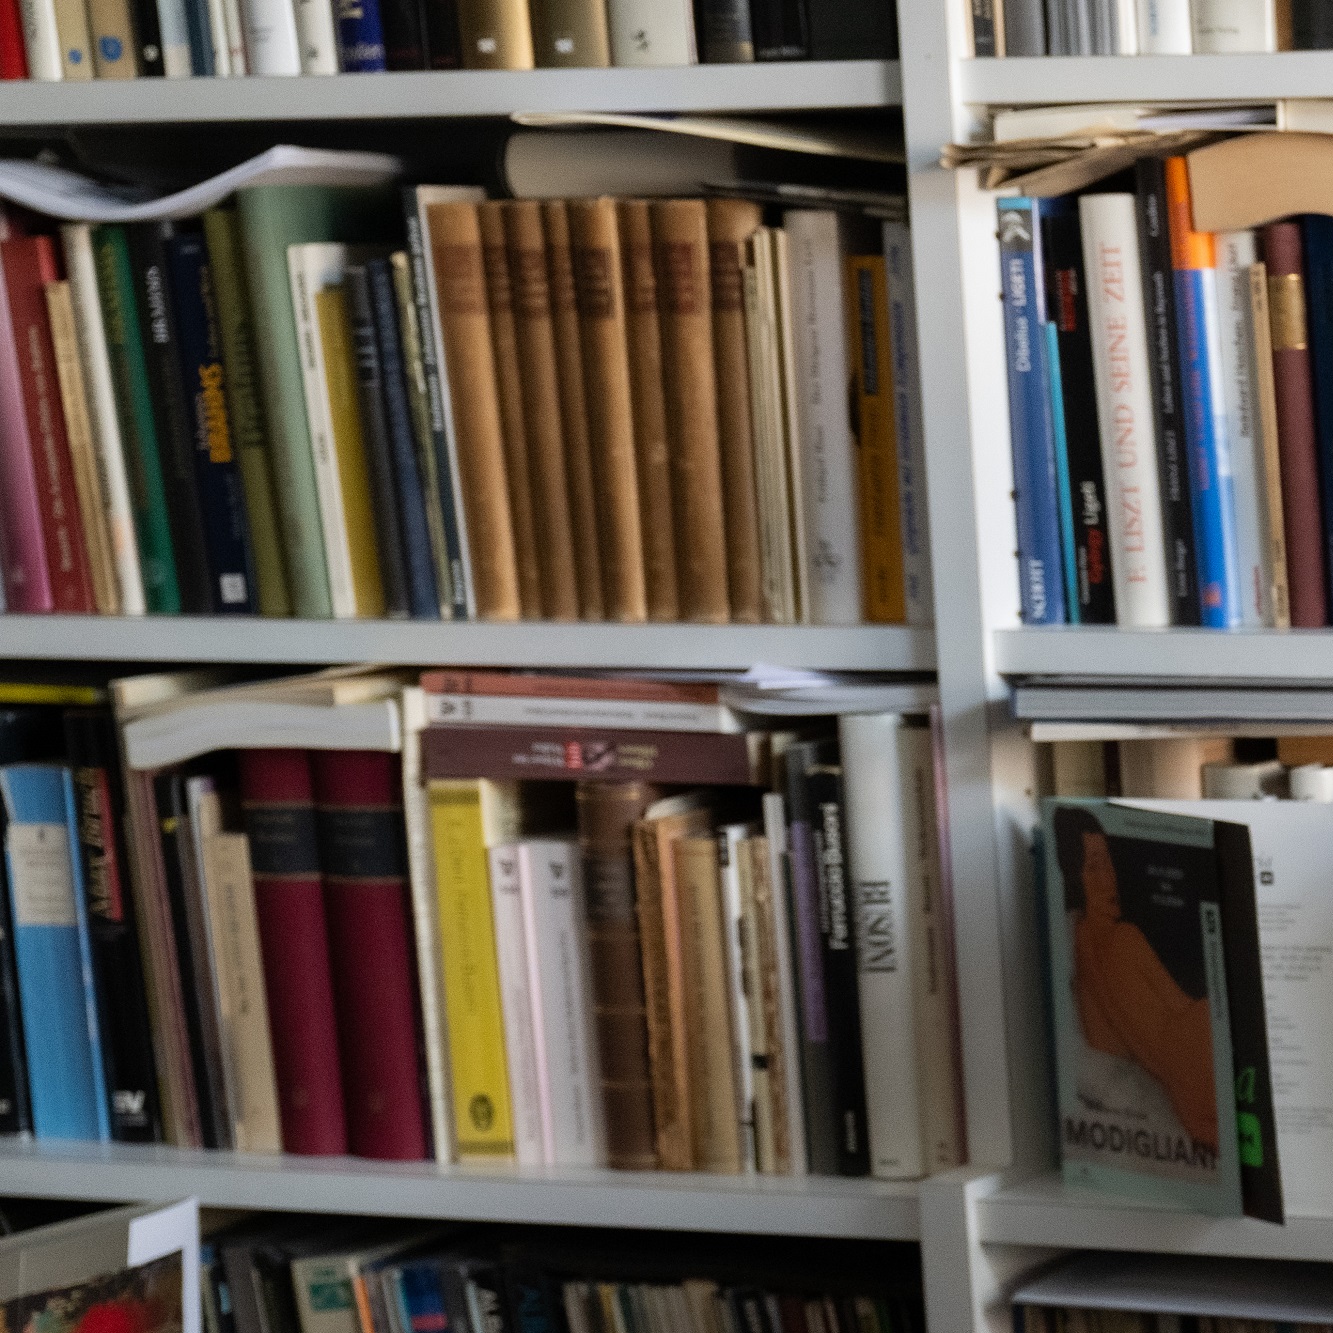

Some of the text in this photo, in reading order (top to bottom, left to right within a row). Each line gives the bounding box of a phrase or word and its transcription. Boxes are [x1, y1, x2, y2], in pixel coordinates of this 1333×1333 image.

[1010, 259, 1027, 306] LIGETI
[1100, 241, 1143, 552] LISZT UND SEINE ZEIT
